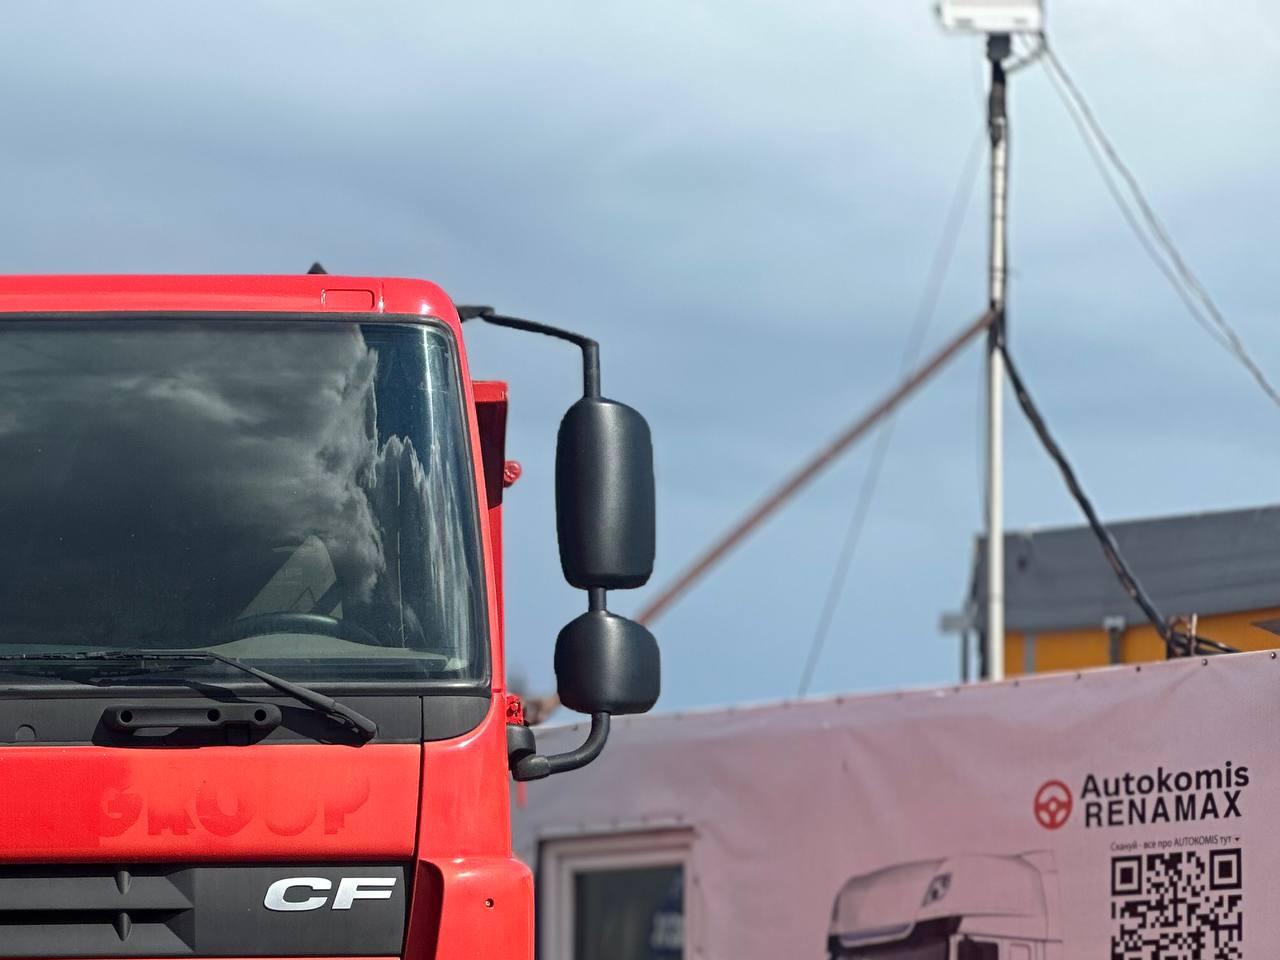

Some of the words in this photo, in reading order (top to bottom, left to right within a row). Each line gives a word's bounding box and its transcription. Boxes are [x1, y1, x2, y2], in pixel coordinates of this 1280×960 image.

[1080, 761, 1249, 799] Autokomis
[1085, 790, 1242, 828] RENAMAX
[1111, 841, 1138, 852] Скануй
[1143, 840, 1156, 849] все
[1157, 839, 1172, 849] про
[1174, 835, 1218, 847] AUTOKOMIS
[1220, 835, 1231, 846] тут
[263, 877, 397, 911] CF
